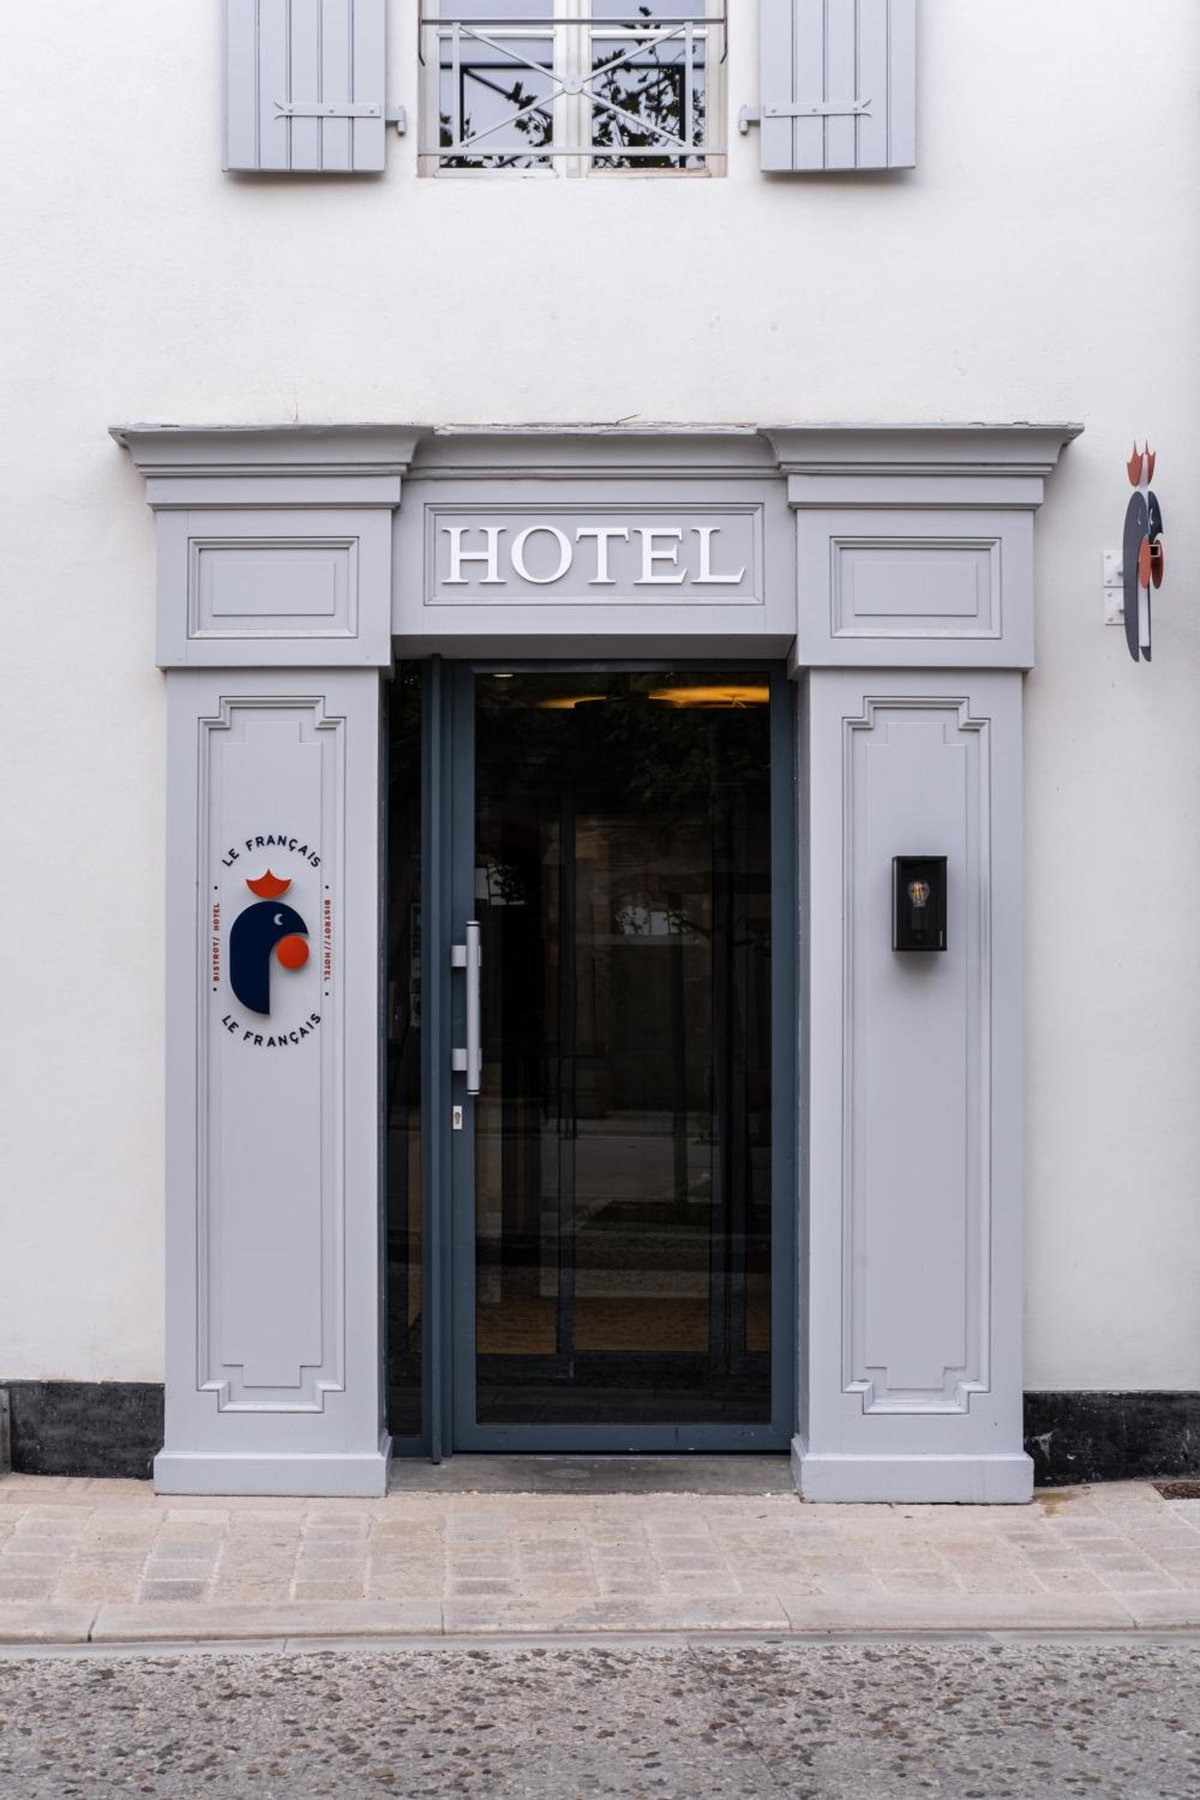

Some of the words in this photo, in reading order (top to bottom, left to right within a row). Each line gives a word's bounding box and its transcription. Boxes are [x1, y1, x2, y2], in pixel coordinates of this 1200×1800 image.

[441, 525, 746, 585] HOTEL
[222, 848, 240, 867] LE
[245, 835, 321, 868] FRANÇAIS
[212, 903, 220, 931] HOTEL
[222, 1014, 239, 1034] LE
[243, 1013, 322, 1047] FRANÇAIS
